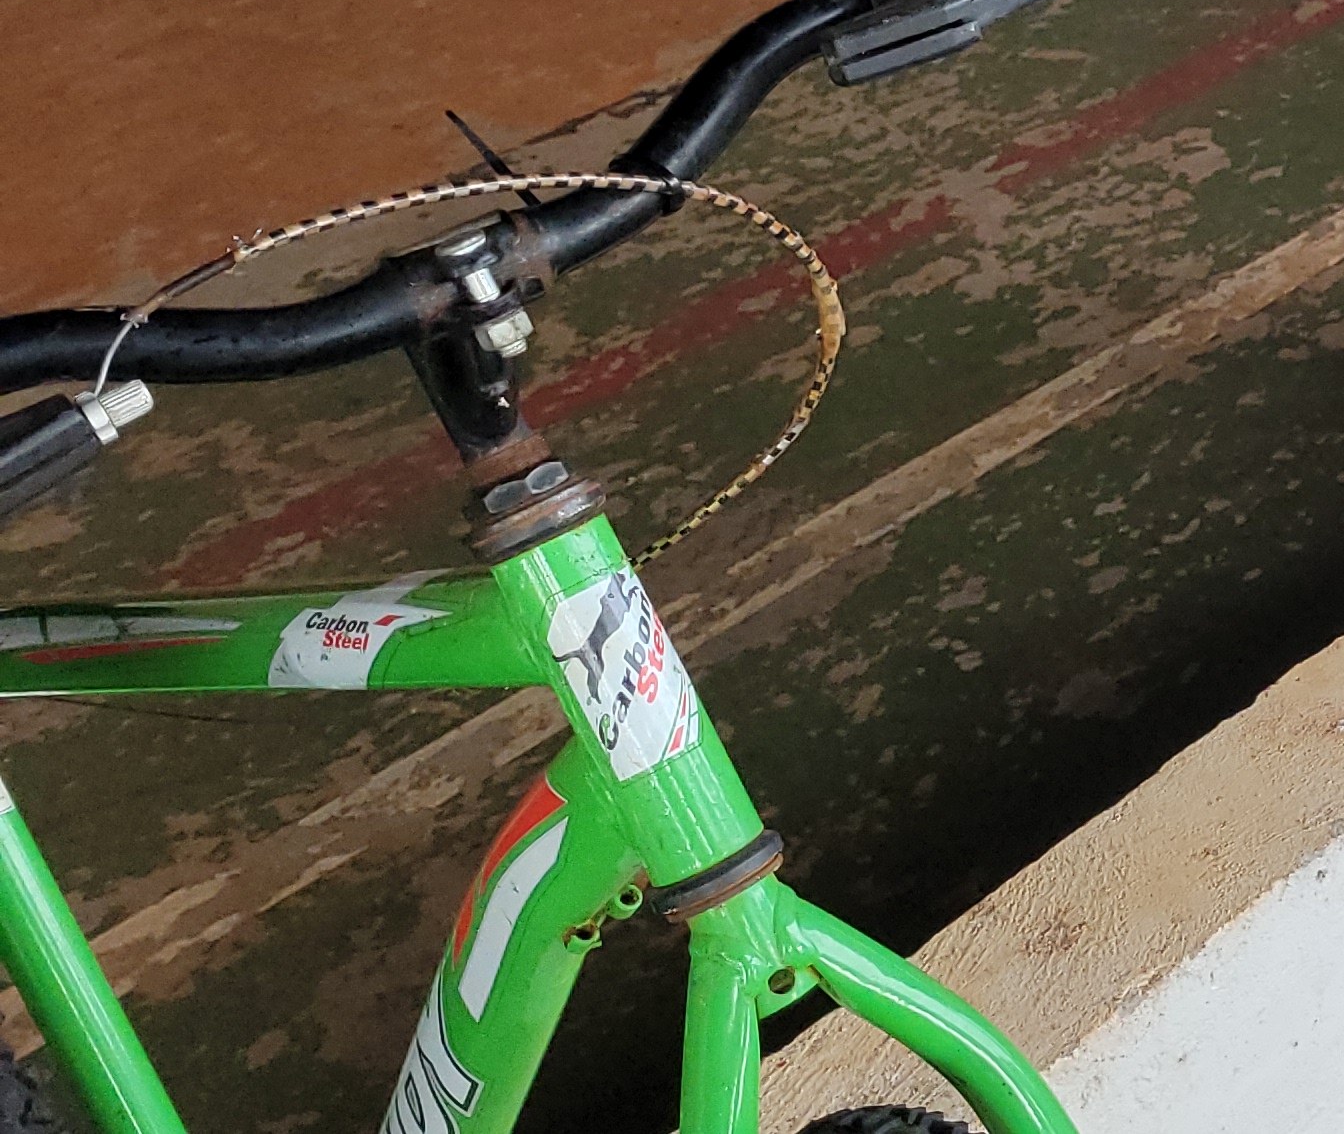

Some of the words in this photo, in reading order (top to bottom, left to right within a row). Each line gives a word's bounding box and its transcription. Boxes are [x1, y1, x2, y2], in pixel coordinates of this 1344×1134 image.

[305, 611, 369, 633] Carbon
[322, 630, 370, 653] Steel
[598, 590, 652, 751] Carbon
